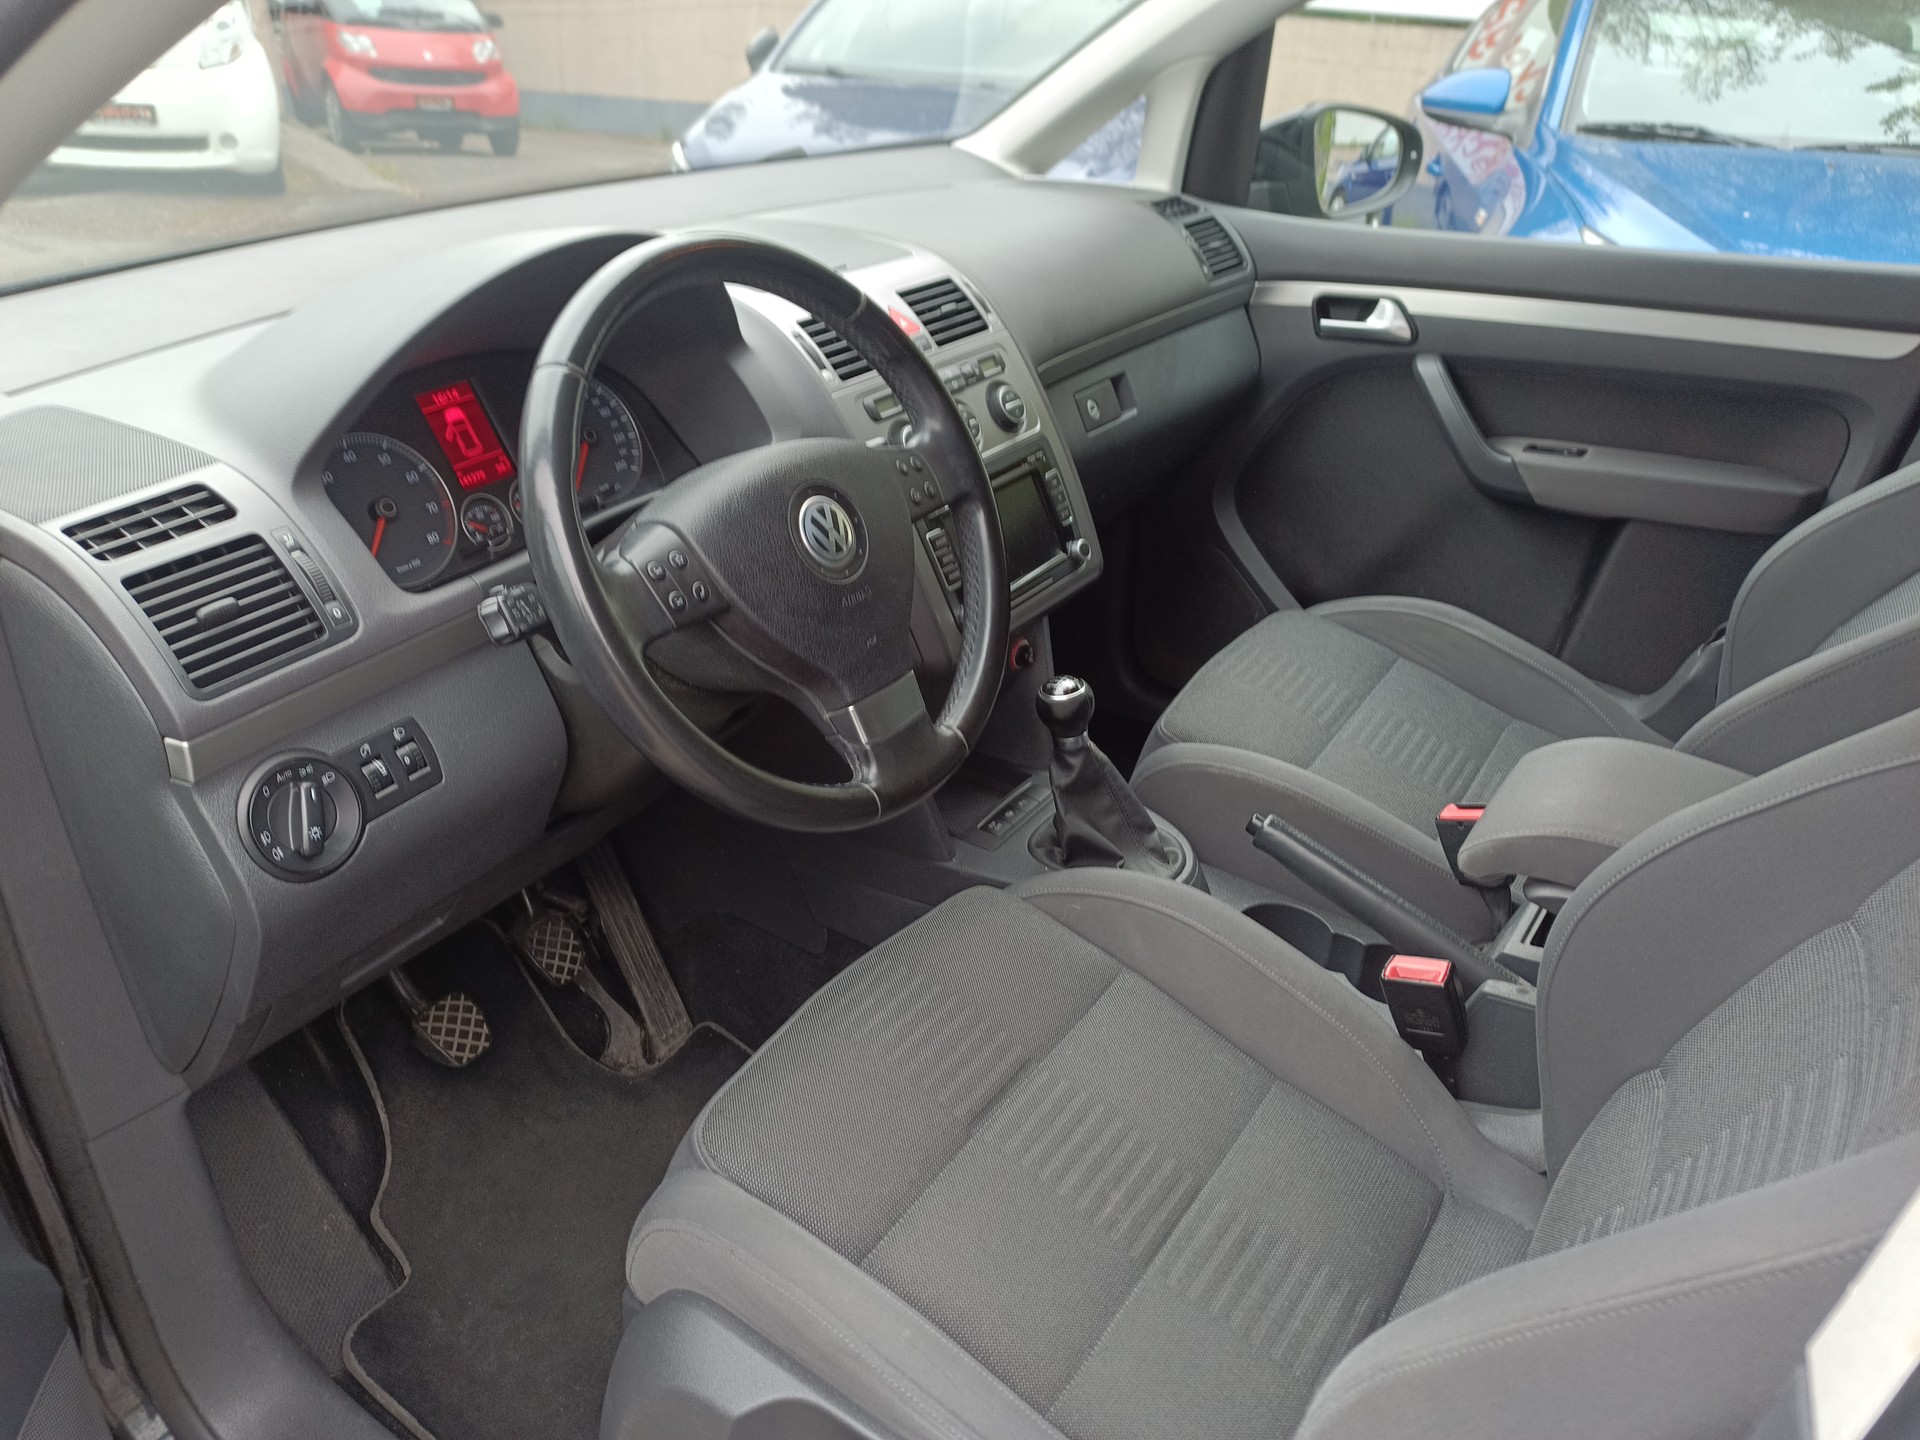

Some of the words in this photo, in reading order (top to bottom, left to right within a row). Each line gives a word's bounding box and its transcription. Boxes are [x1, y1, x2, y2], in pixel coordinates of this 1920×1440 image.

[343, 450, 357, 463] 40
[378, 452, 391, 466] 50
[405, 470, 419, 484] 60
[425, 501, 438, 515] 70
[426, 531, 439, 545] 80
